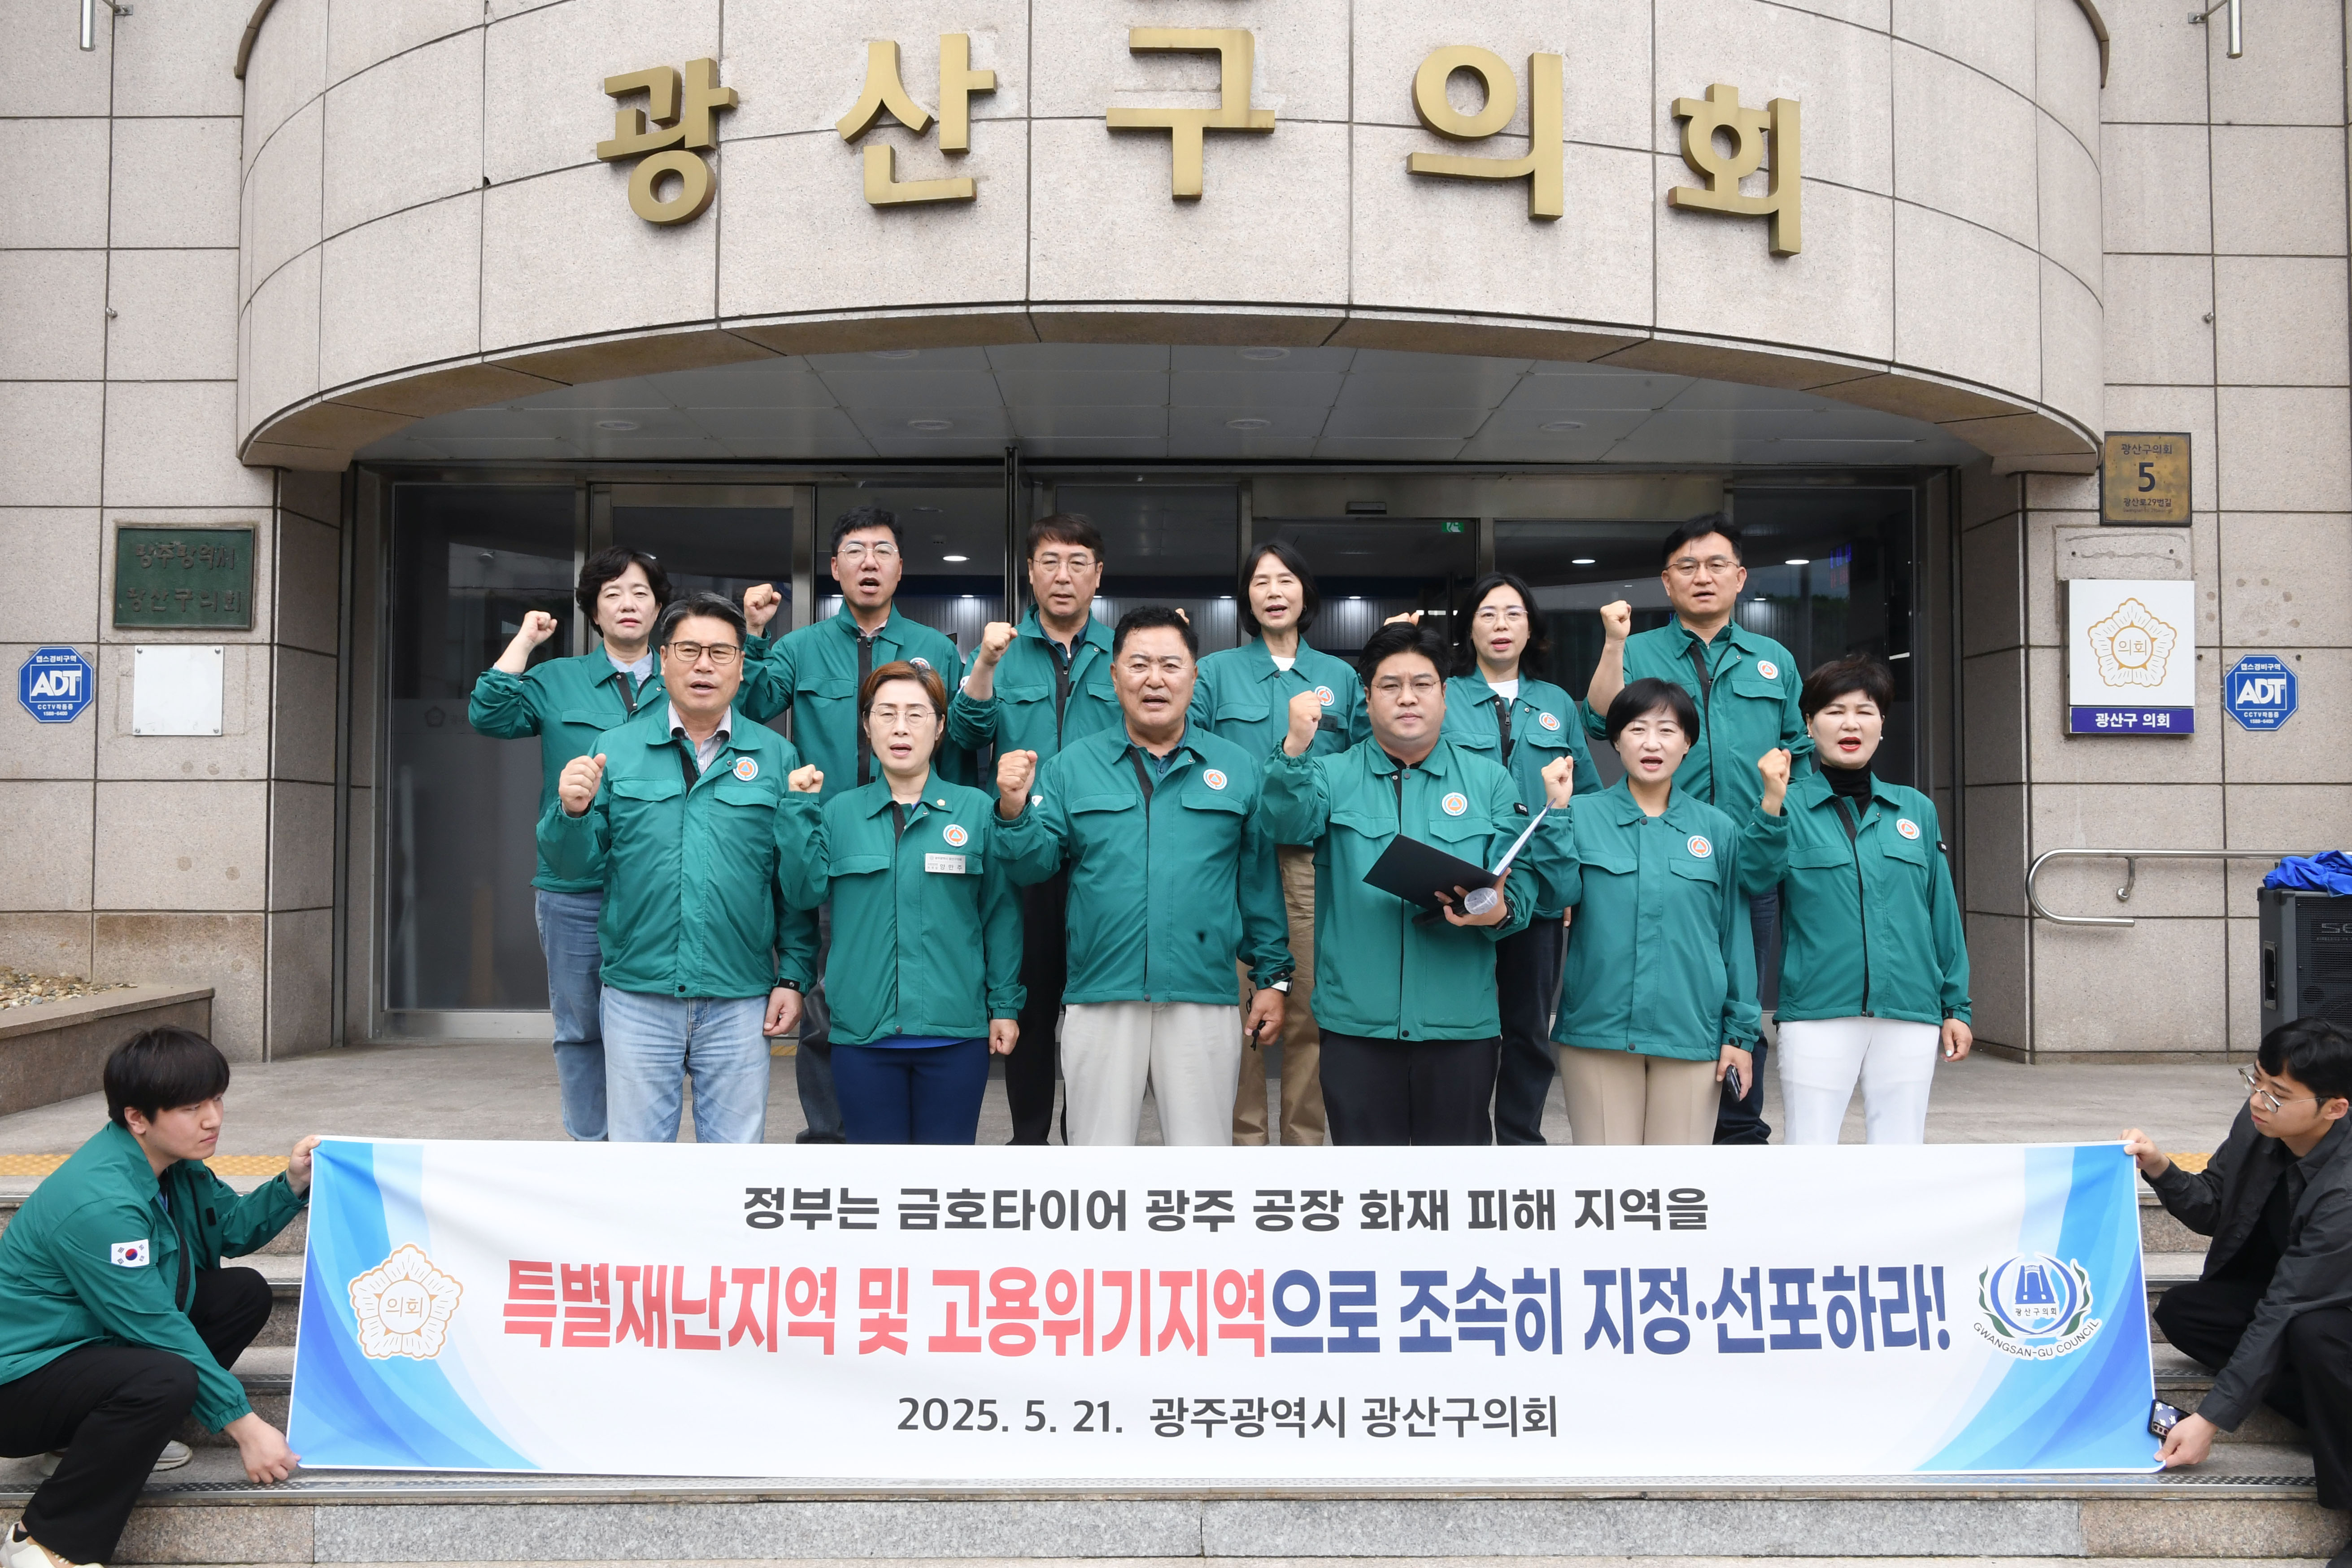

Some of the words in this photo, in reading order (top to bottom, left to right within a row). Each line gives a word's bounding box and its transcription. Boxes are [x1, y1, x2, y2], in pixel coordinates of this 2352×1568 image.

[2121, 444, 2172, 455] 광산구의회
[2138, 462, 2156, 492] 5
[2123, 498, 2172, 507] 광산로29번길
[135, 543, 235, 570] 광주광역시
[126, 587, 241, 613] 광산구의회
[2118, 640, 2147, 656] 의회
[30, 671, 81, 696] ADT
[2237, 678, 2287, 704] ADT
[2095, 713, 2138, 727] 광산구
[2142, 713, 2170, 727] 의회
[744, 1187, 880, 1230] 정부는
[897, 1188, 1126, 1232] 금호타이어
[1146, 1189, 1235, 1233] 광주
[1253, 1189, 1344, 1232] 공장
[1359, 1189, 1449, 1232] 화재
[1468, 1189, 1556, 1231] 피해
[1574, 1188, 1708, 1231] 지역을
[386, 1297, 423, 1318] 의회
[503, 1259, 837, 1355] 특별재난지역
[858, 1267, 909, 1355] 및
[928, 1267, 1381, 1358] 고용위기지역으로
[1399, 1267, 1563, 1356] 조속히
[2015, 1307, 2057, 1317] 광산구의회
[1973, 1322, 2053, 1358] GWANGSAN-GU
[2056, 1320, 2099, 1354] COUNCIL
[897, 1397, 1009, 1432] 2025.
[1024, 1399, 1057, 1433] 5.
[1073, 1400, 1123, 1433] 21.
[1150, 1396, 1346, 1438] 광주광역시
[1361, 1395, 1557, 1438] 광산구의회
